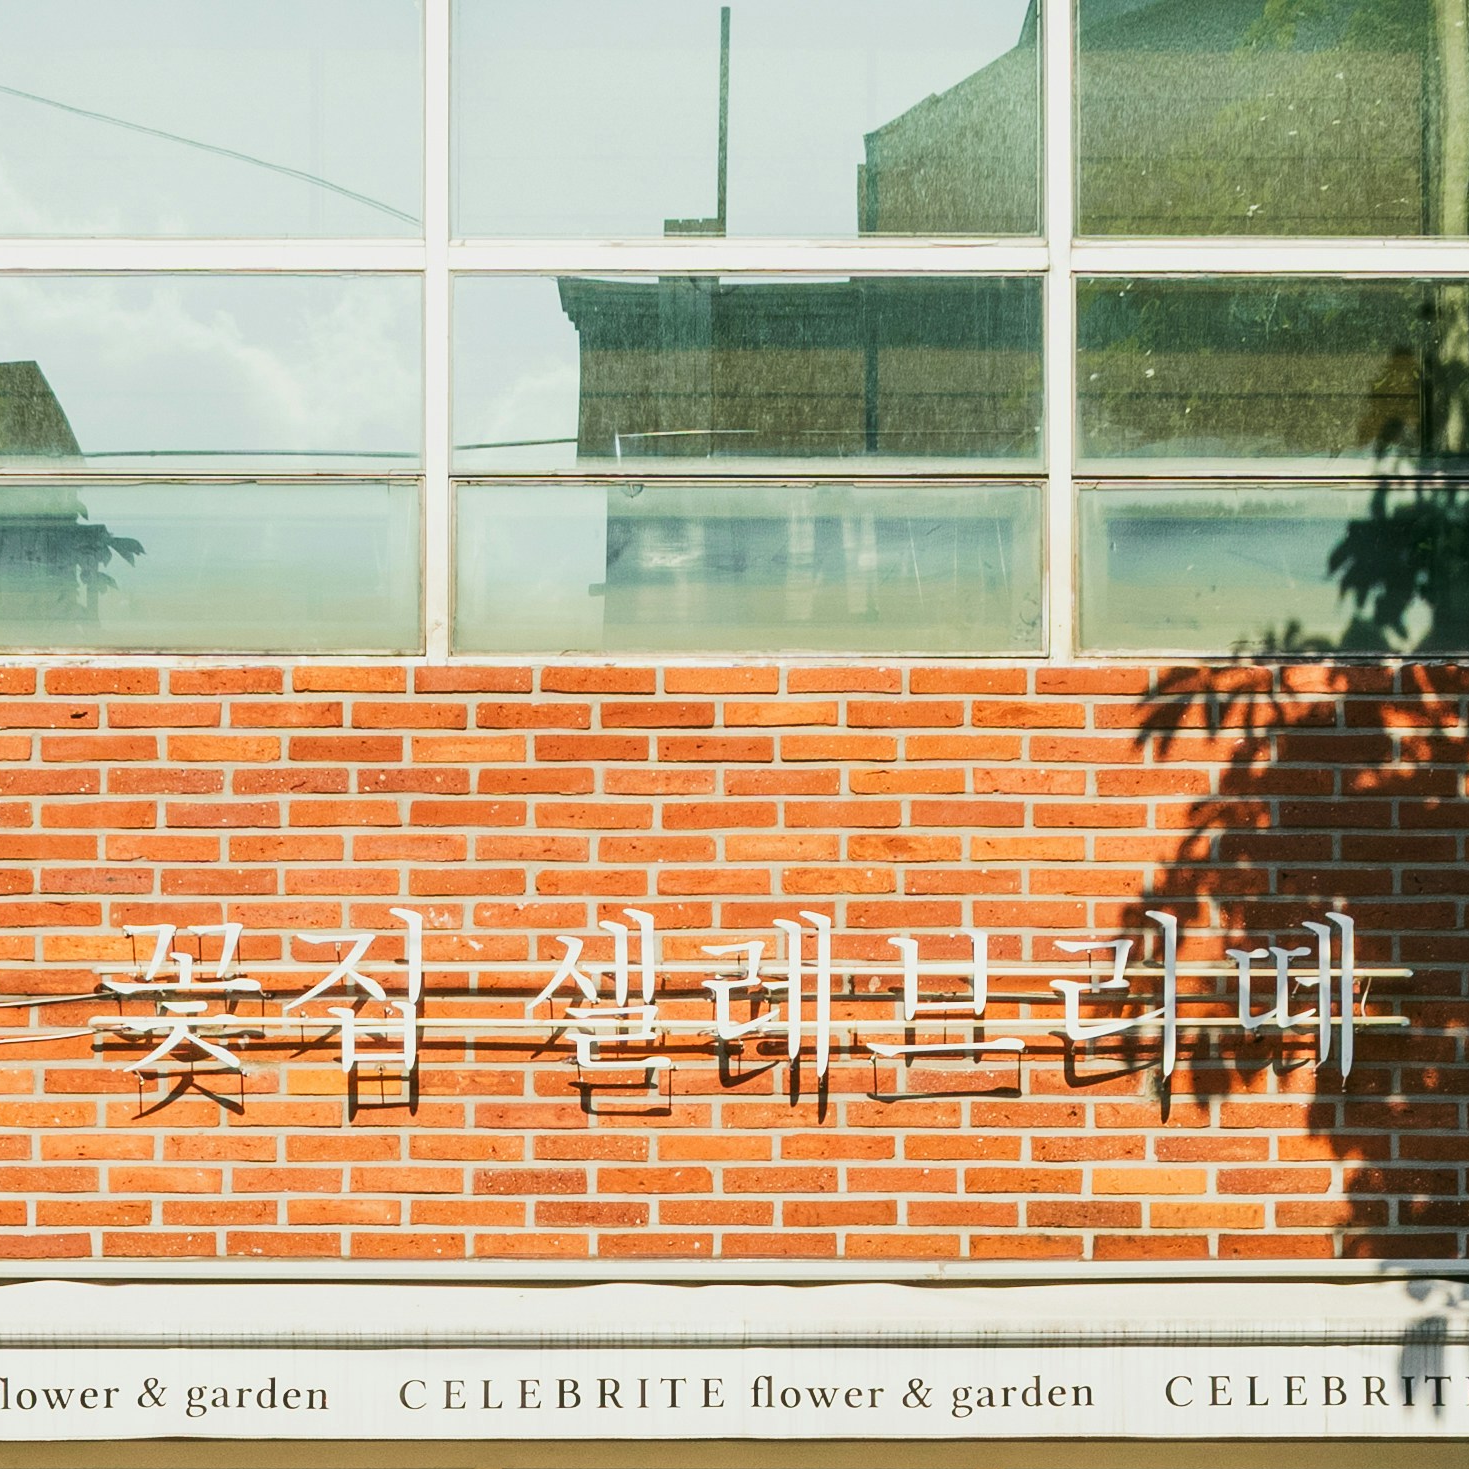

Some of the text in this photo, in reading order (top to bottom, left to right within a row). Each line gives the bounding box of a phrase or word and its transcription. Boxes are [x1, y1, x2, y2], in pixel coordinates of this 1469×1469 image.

[103, 907, 1356, 1079] 꽃집 셀레브리떼
[137, 1376, 168, 1410] &
[185, 1375, 328, 1418] garden
[398, 1374, 1094, 1419] CELEBRITE flower & garden
